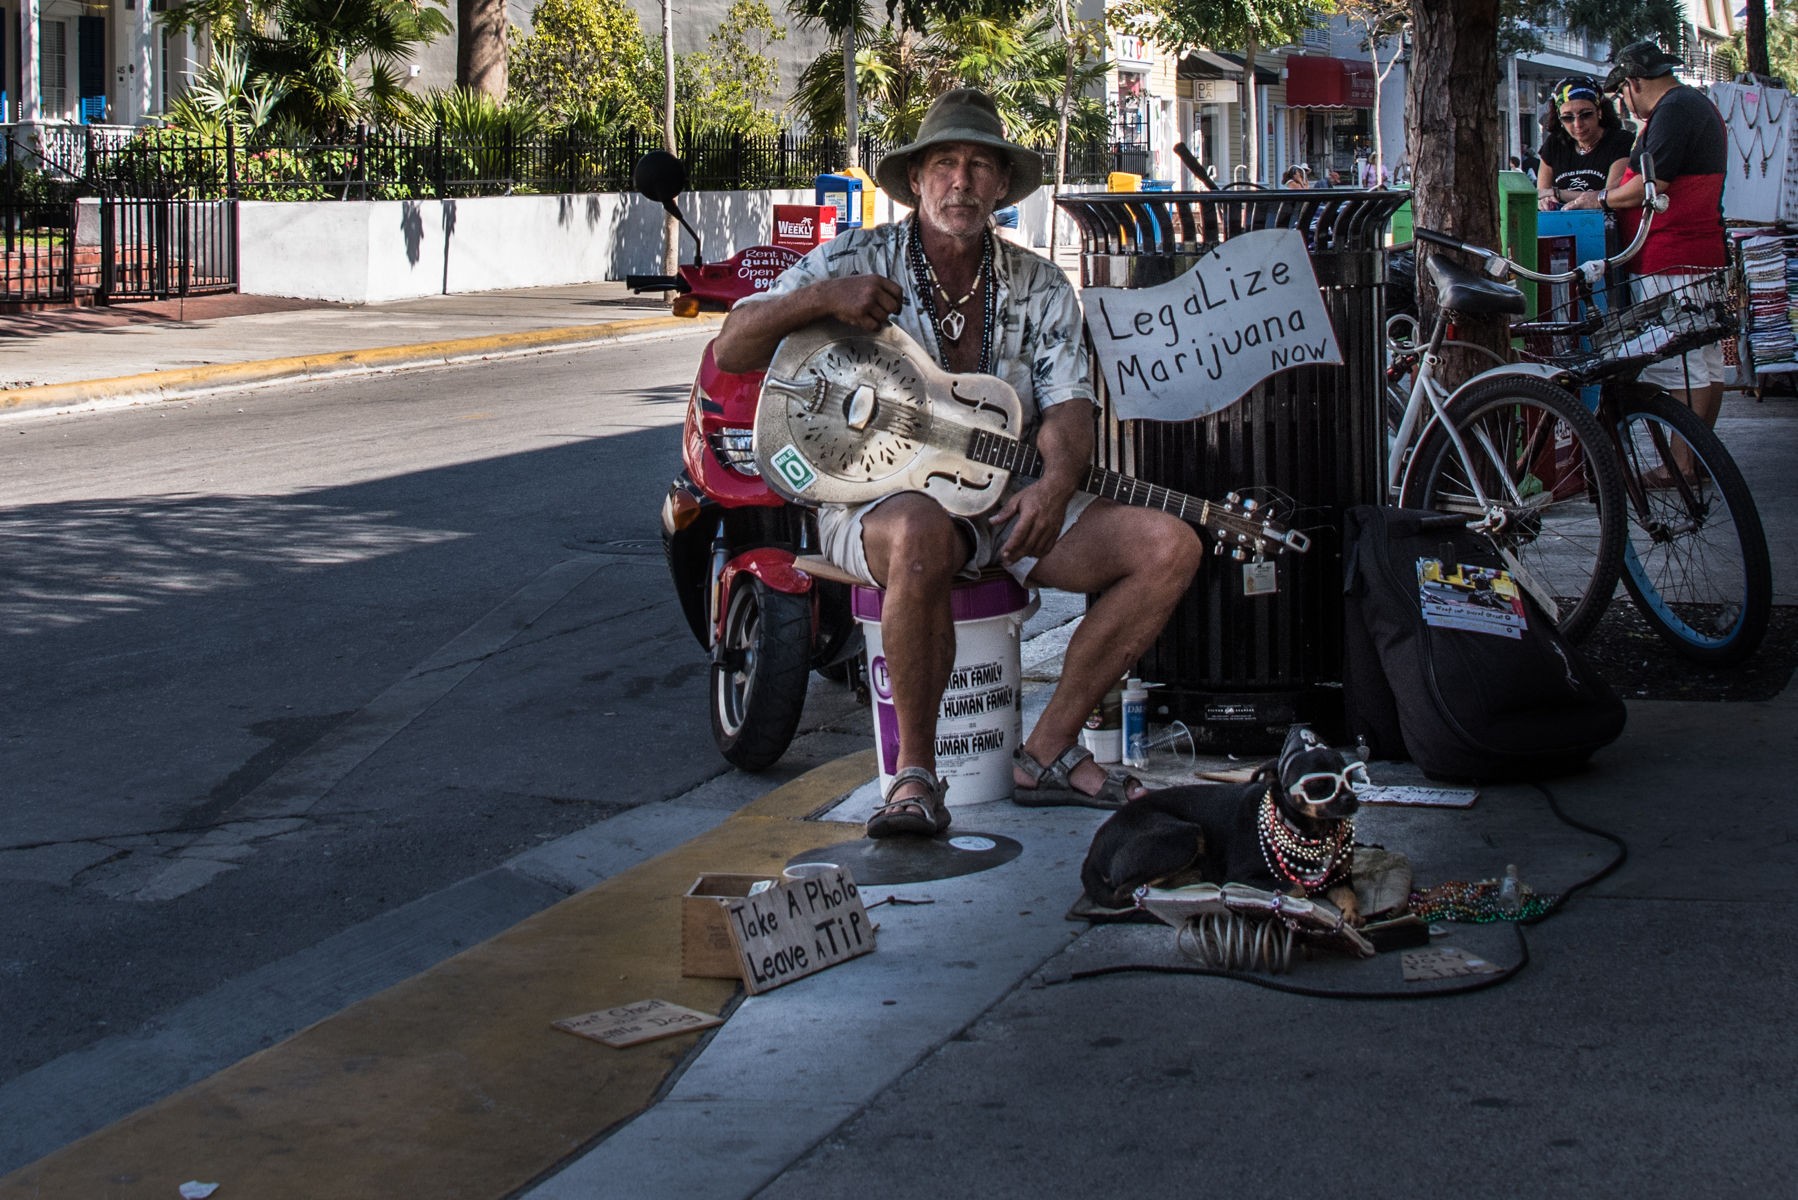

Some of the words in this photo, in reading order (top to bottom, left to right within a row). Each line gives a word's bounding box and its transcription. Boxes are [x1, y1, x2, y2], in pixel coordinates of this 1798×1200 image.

[777, 219, 814, 237] WEEKLY
[745, 249, 778, 258] Rent
[737, 267, 774, 280] Open
[1116, 309, 1306, 395] Marijuana
[1271, 338, 1327, 371] NOW
[775, 448, 795, 467] MILE
[971, 664, 1002, 687] FAMILY
[943, 696, 984, 718] HUMAN
[986, 687, 1013, 711] FAMILY
[934, 737, 969, 757] UMAN
[972, 731, 1004, 753] FAMILY
[731, 902, 778, 942] Take
[787, 889, 802, 919] A
[804, 872, 857, 914] Photo
[747, 945, 809, 984] Leave
[815, 939, 826, 960] A
